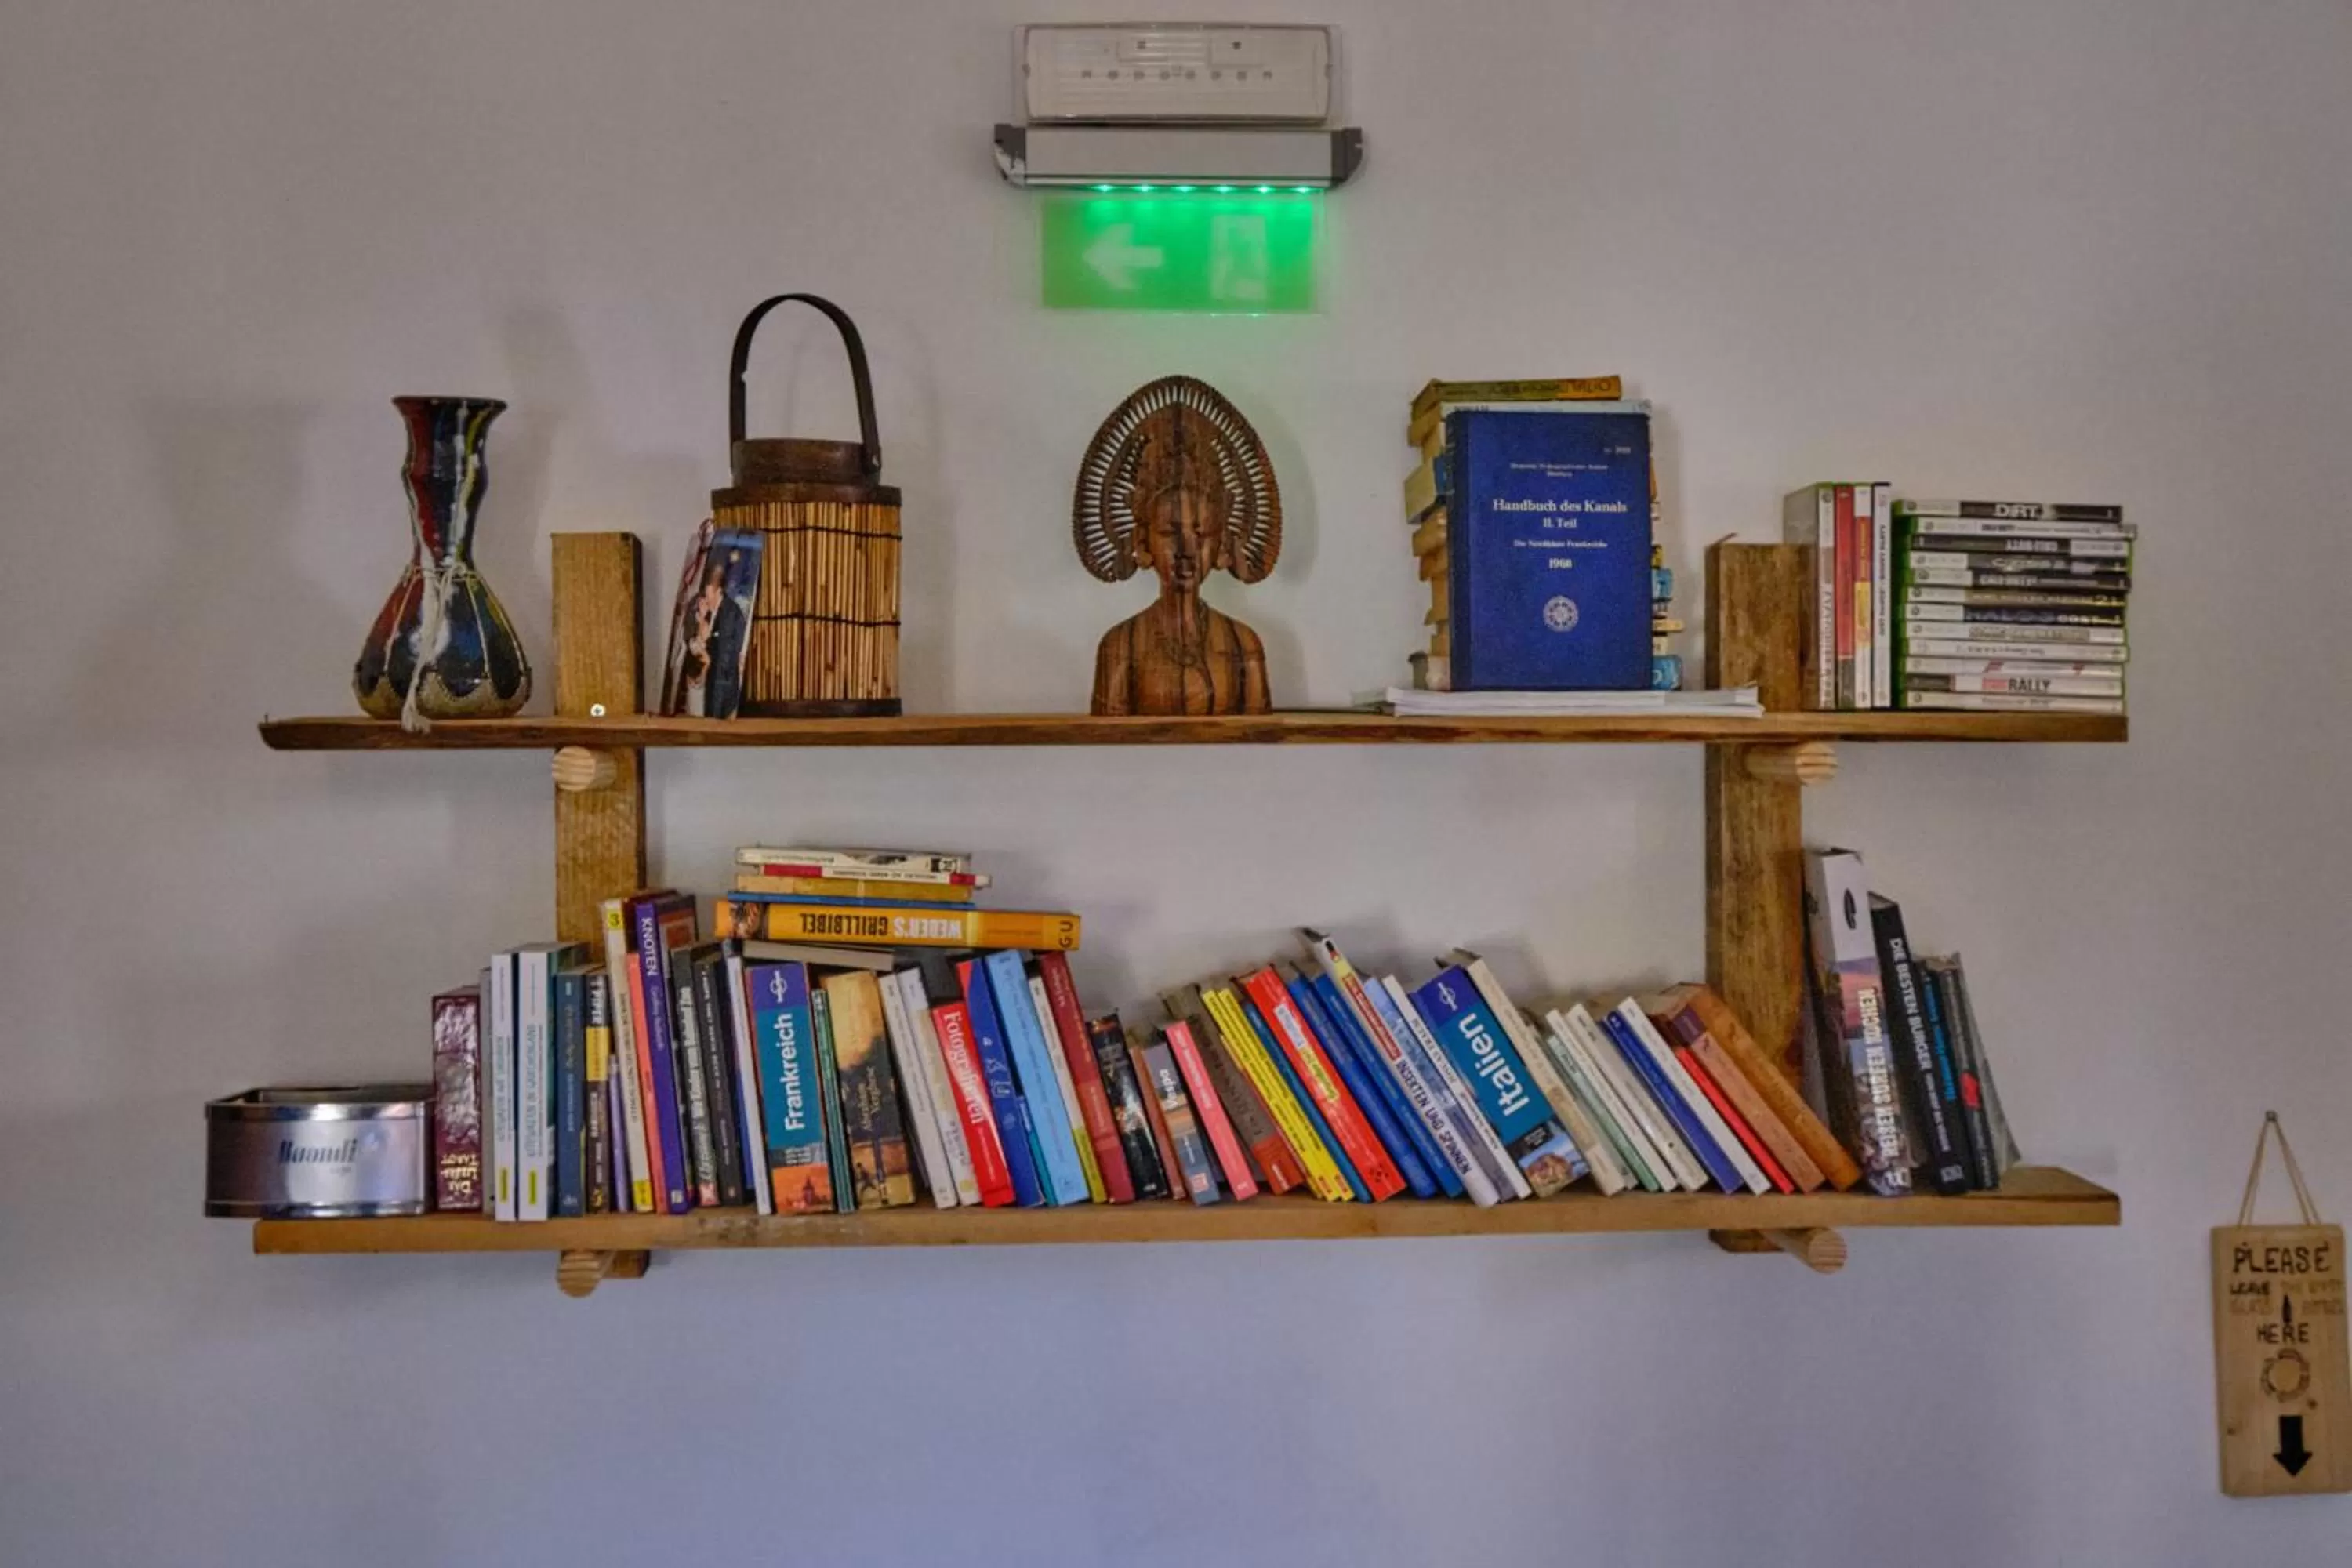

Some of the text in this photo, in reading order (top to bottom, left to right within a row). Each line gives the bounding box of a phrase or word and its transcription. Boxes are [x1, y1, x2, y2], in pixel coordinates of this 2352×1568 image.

[1493, 499, 1628, 512] Handbuch des Kanals
[1558, 518, 1577, 528] Teil
[2008, 678, 2051, 691] RALLY
[609, 913, 619, 927] 3
[800, 913, 962, 939] WEBER'S GRILLBIBEL
[641, 917, 659, 976] KNOTEN
[1889, 938, 1906, 961] DIE
[1896, 963, 1919, 1015] BESTEN
[1908, 1016, 1933, 1072] BURGER
[774, 1013, 805, 1131] Frankreich
[944, 1011, 984, 1125] Fotografieren
[1458, 1012, 1530, 1116] Italien
[1160, 1069, 1178, 1110] Vespa
[1396, 1061, 1431, 1108] INSEKTEN
[1425, 1106, 1445, 1131] UND
[1439, 1130, 1472, 1175] SPINNEN
[2233, 1243, 2330, 1274] PLEASE
[2256, 1323, 2310, 1345] HERE
